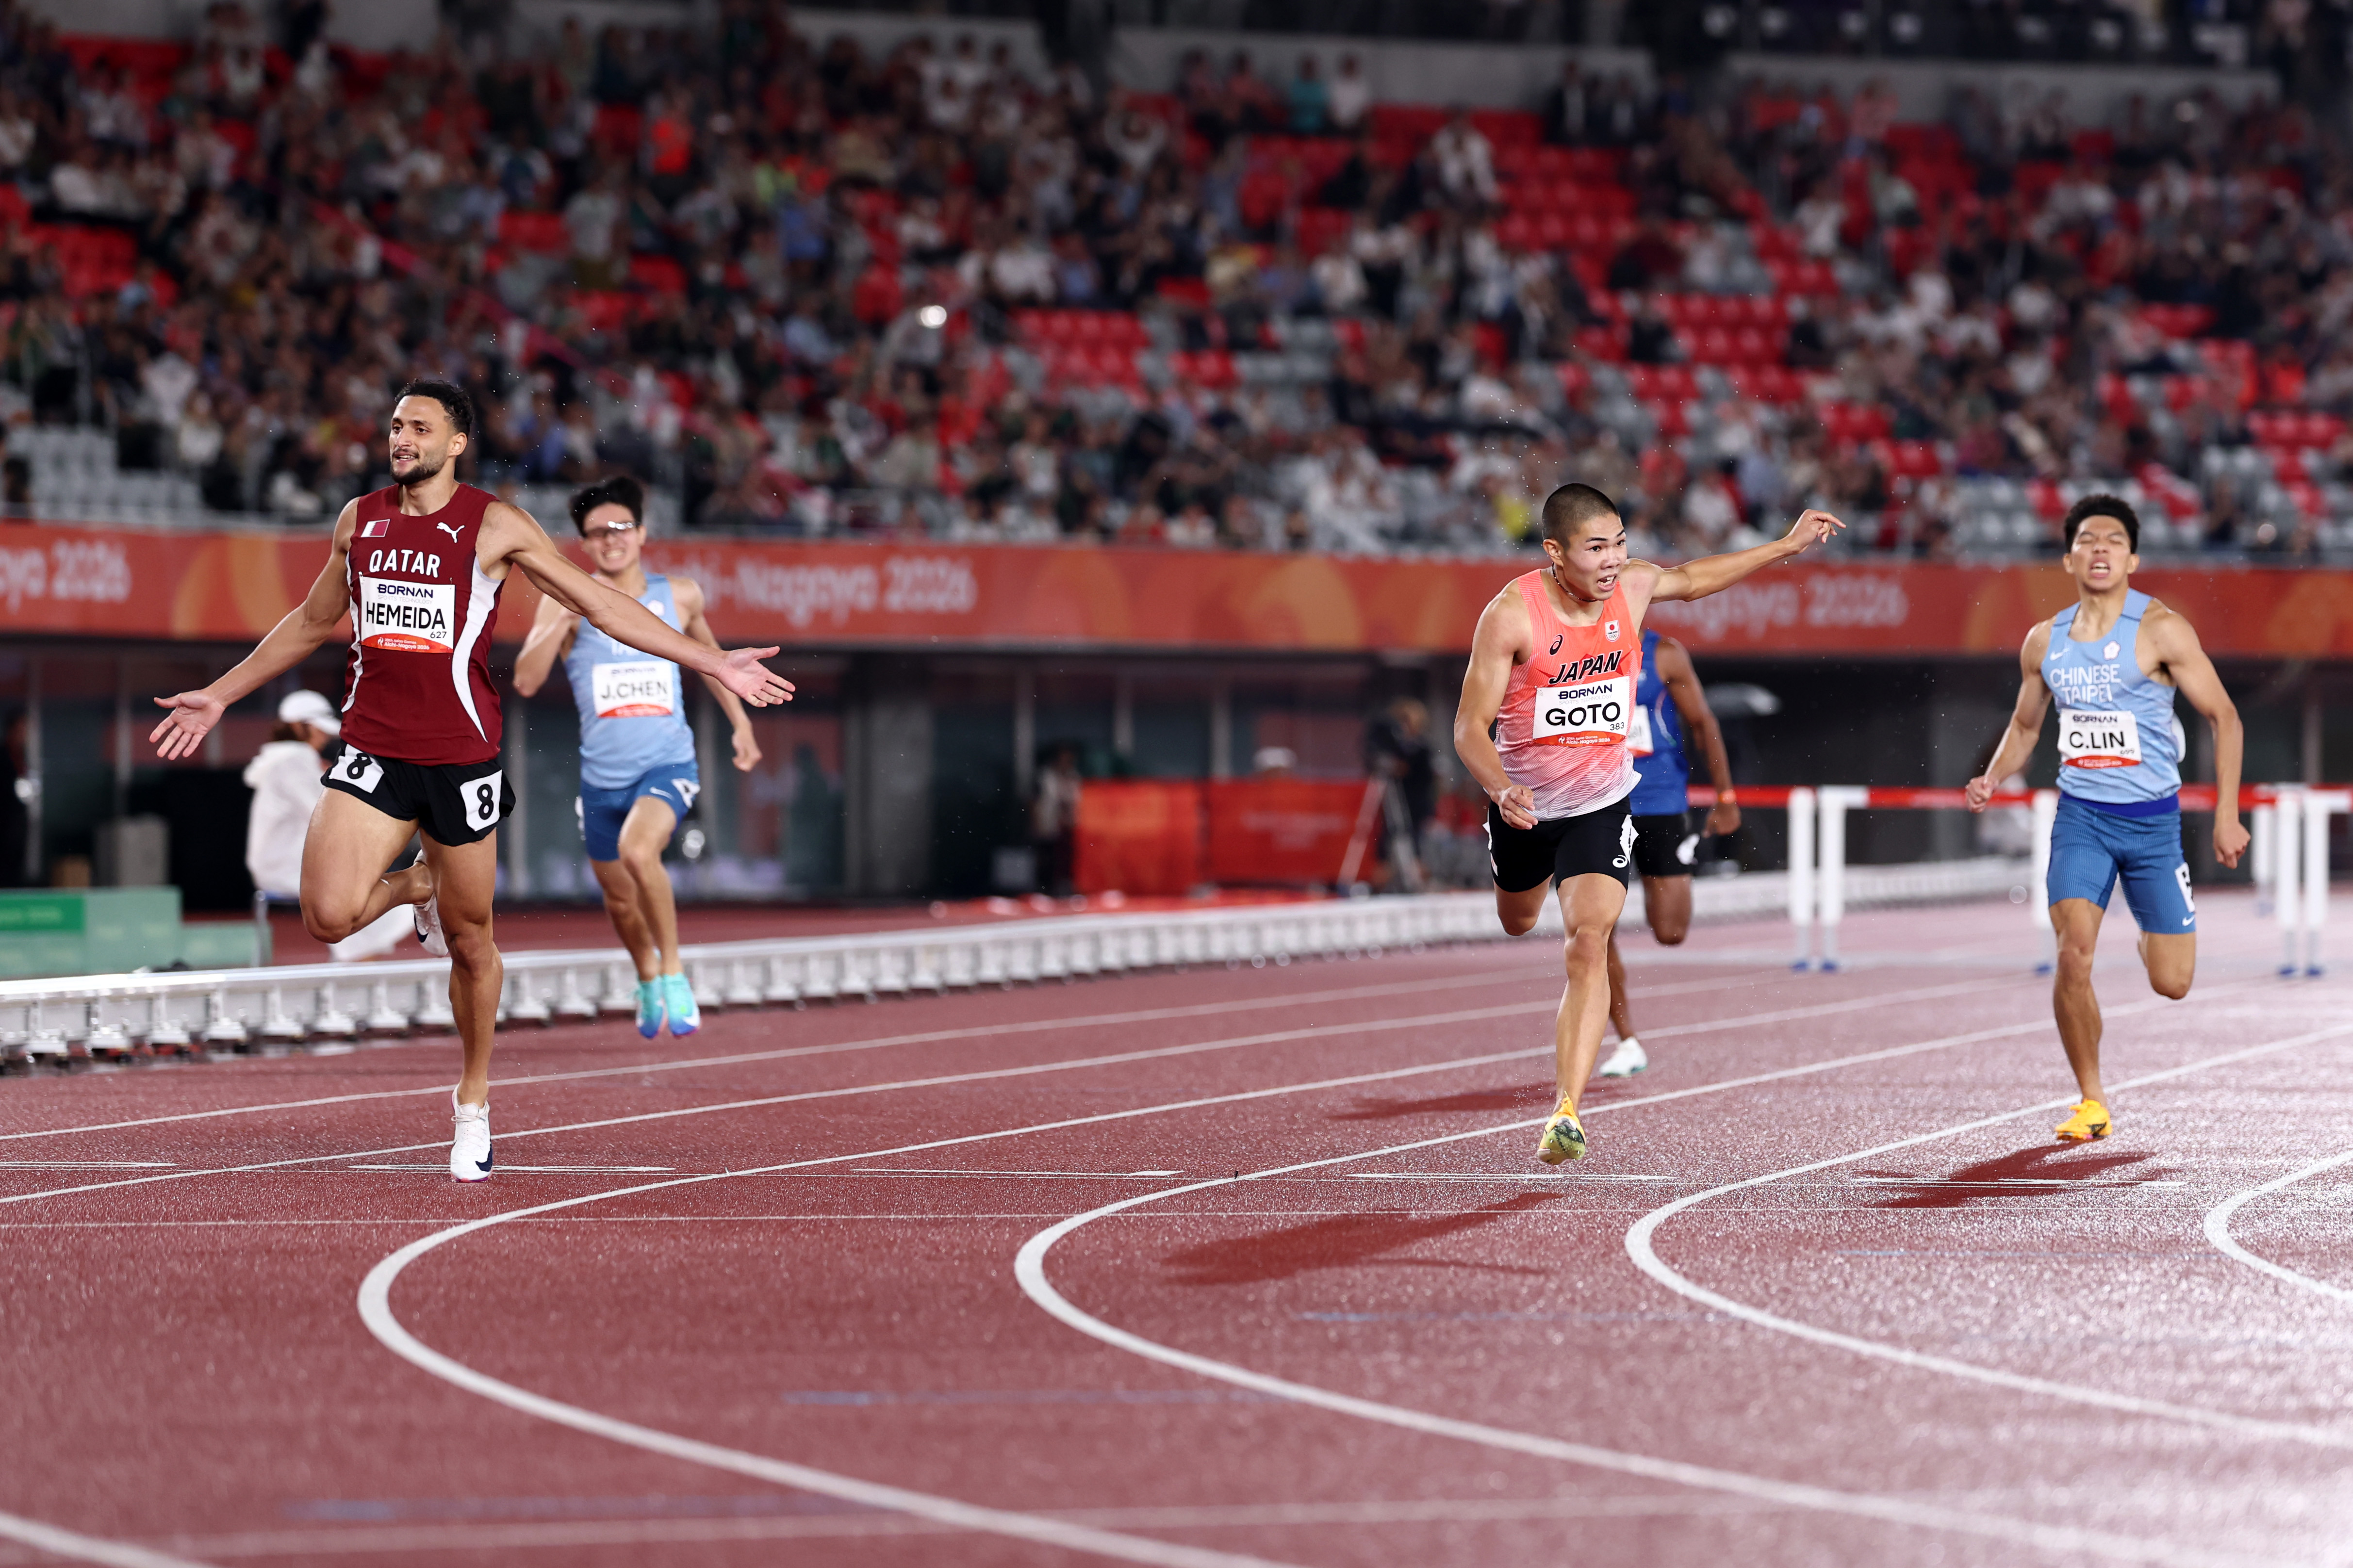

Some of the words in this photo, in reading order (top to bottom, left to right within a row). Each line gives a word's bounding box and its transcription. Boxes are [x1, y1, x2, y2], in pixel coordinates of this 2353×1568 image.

[369, 549, 441, 578] QATAR
[377, 584, 433, 599] BORNAN
[399, 596, 433, 605] TECHNOLOGY
[366, 601, 446, 630] HEMEIDA
[1548, 650, 1623, 685] JAPAN
[2049, 664, 2122, 688] CHINESE
[600, 681, 668, 700] J.CHEN
[1557, 684, 1613, 700] BORNAN
[1580, 694, 1613, 704] TECHNOLOGY
[2061, 683, 2113, 705] TAIPEI
[1545, 702, 1621, 726] GOTO
[2073, 714, 2118, 723] BORNAN
[1610, 722, 1625, 731] 383
[2069, 731, 2125, 749] C.LIN
[346, 753, 373, 780] 8
[477, 784, 494, 820] 8
